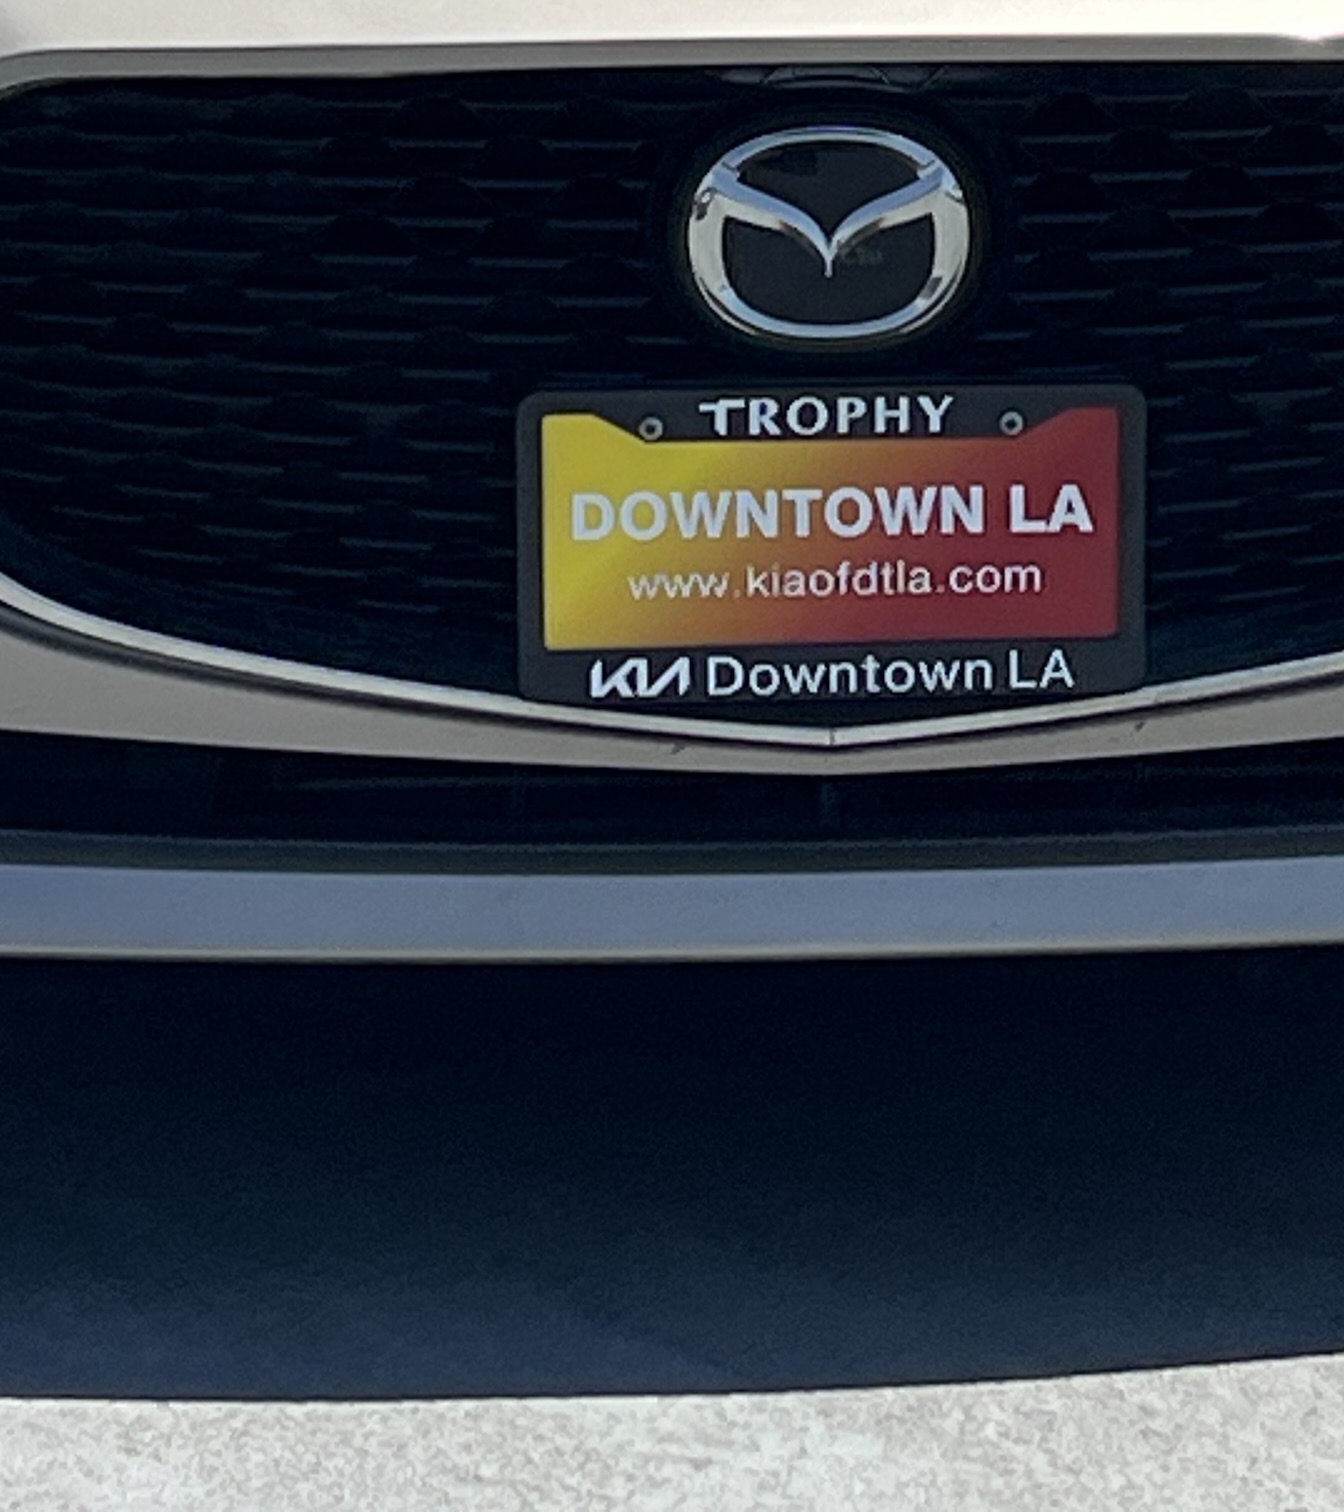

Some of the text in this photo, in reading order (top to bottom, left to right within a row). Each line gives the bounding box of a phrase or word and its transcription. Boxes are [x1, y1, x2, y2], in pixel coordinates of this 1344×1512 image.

[699, 395, 955, 437] TROPHY
[570, 484, 1094, 542] DOWNTOWN LA
[626, 560, 1042, 601] www.kiaofdtla.com
[589, 650, 1075, 699] KIA Downtown LA
